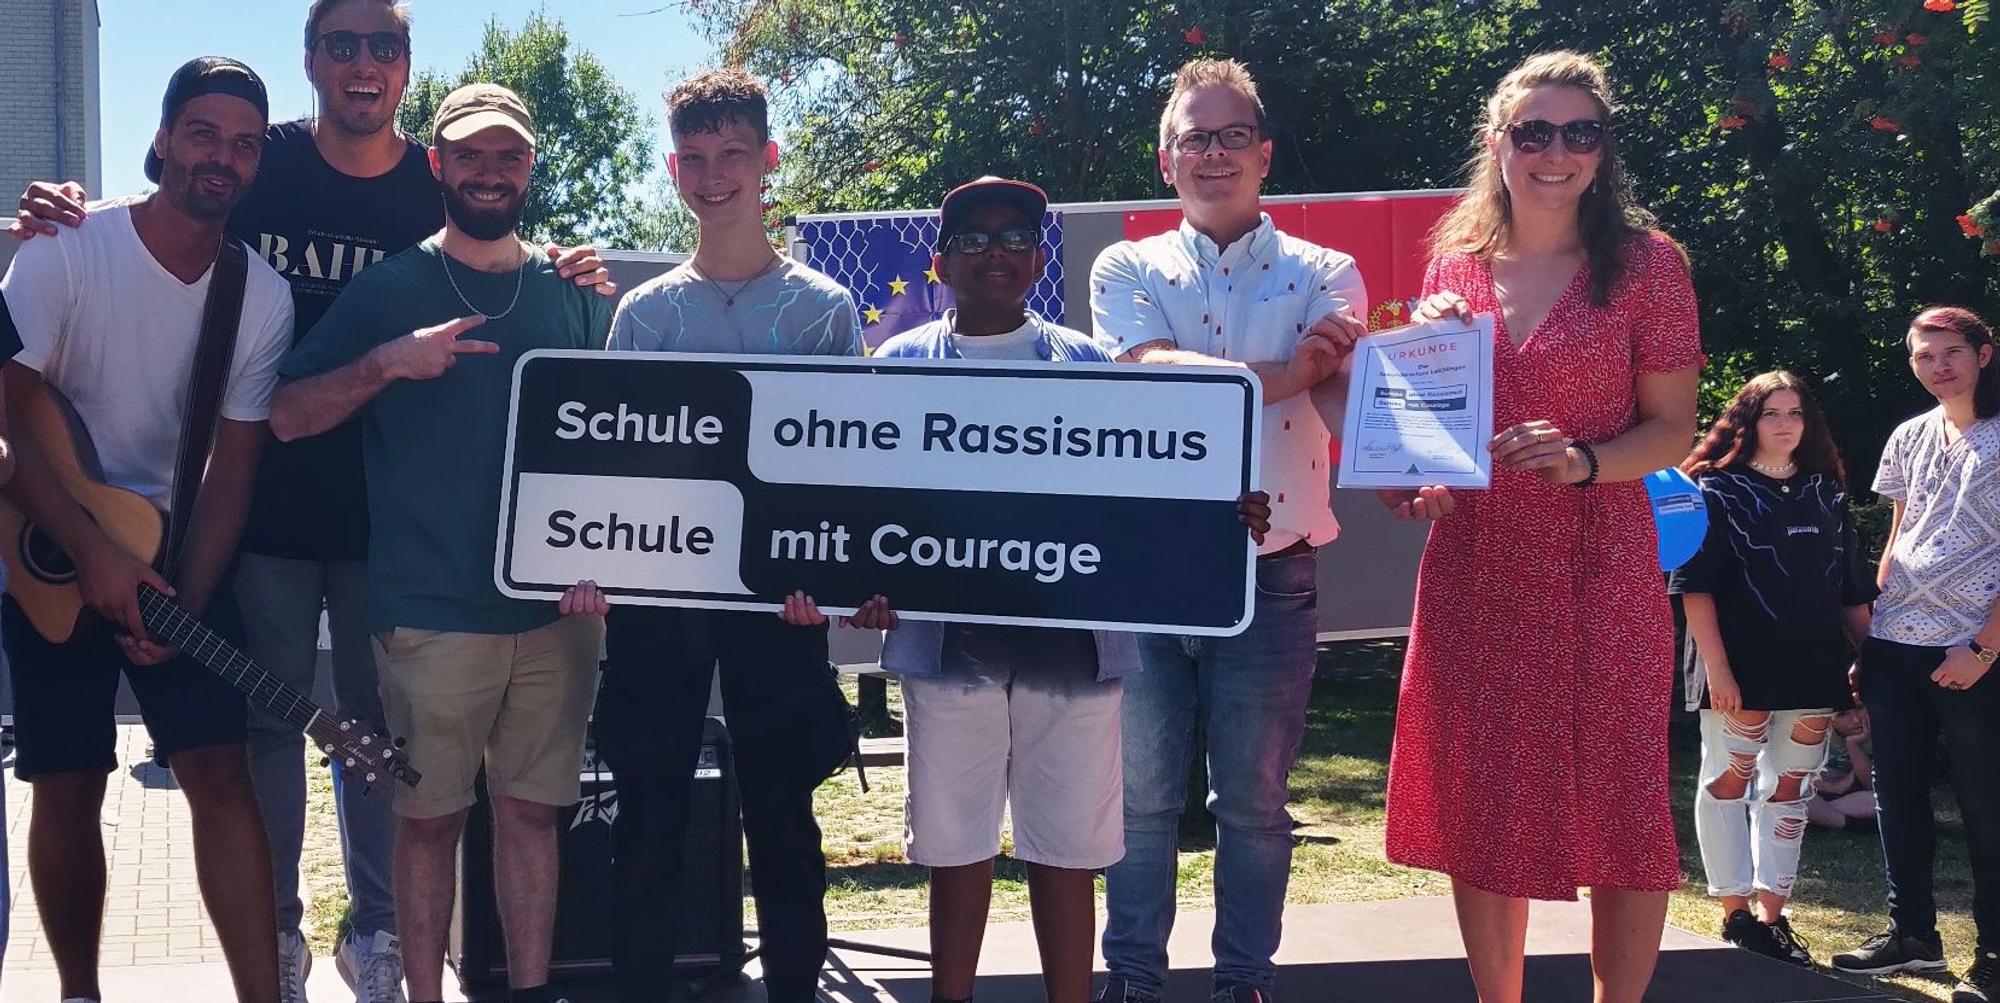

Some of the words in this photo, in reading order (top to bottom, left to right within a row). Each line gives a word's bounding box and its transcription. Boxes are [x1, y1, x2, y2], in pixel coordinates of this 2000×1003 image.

[1387, 342, 1458, 361] URKUNDE
[554, 400, 723, 445] Schule
[773, 409, 901, 451] ohne
[922, 412, 1207, 461] Rassismus
[545, 509, 715, 556] Schule
[770, 520, 851, 563] mit
[870, 523, 1101, 583] Courage
